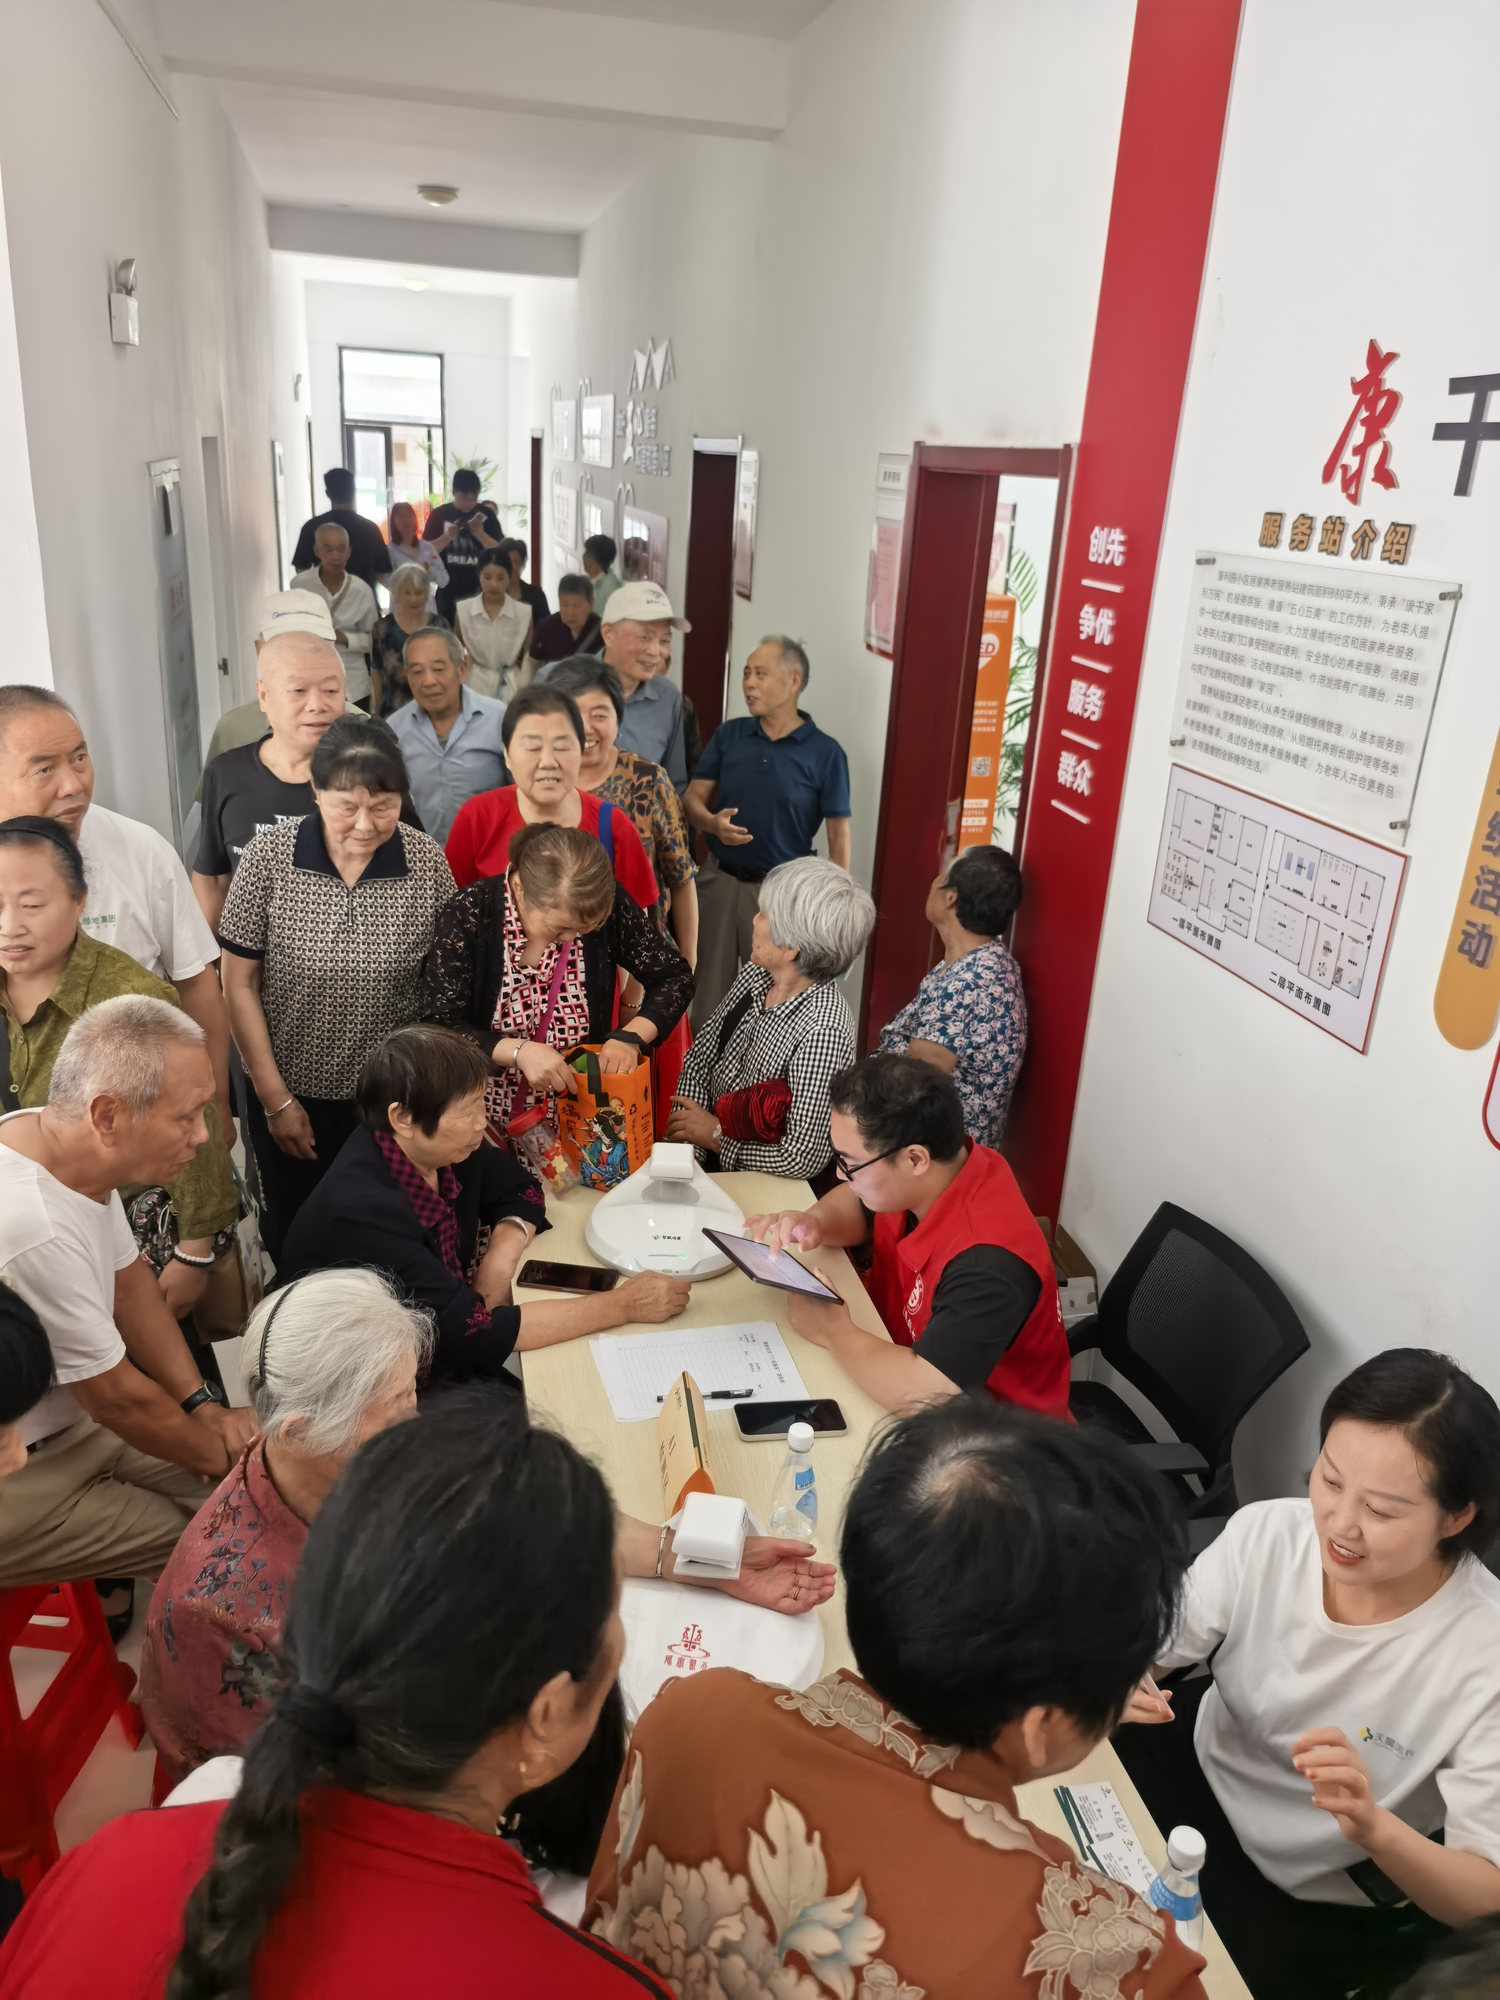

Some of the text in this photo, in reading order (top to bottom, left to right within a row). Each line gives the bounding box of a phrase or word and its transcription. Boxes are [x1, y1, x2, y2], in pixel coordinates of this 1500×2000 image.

[1088, 526, 1127, 567] 创先
[1259, 511, 1416, 565] 服务站介绍
[1079, 604, 1115, 646] 争优
[979, 641, 996, 655] ED
[1067, 679, 1103, 721] 服务
[1057, 751, 1094, 797] 群众
[1172, 917, 1222, 951] 一层平面布置图
[1269, 971, 1332, 1017] 二层平面布置图
